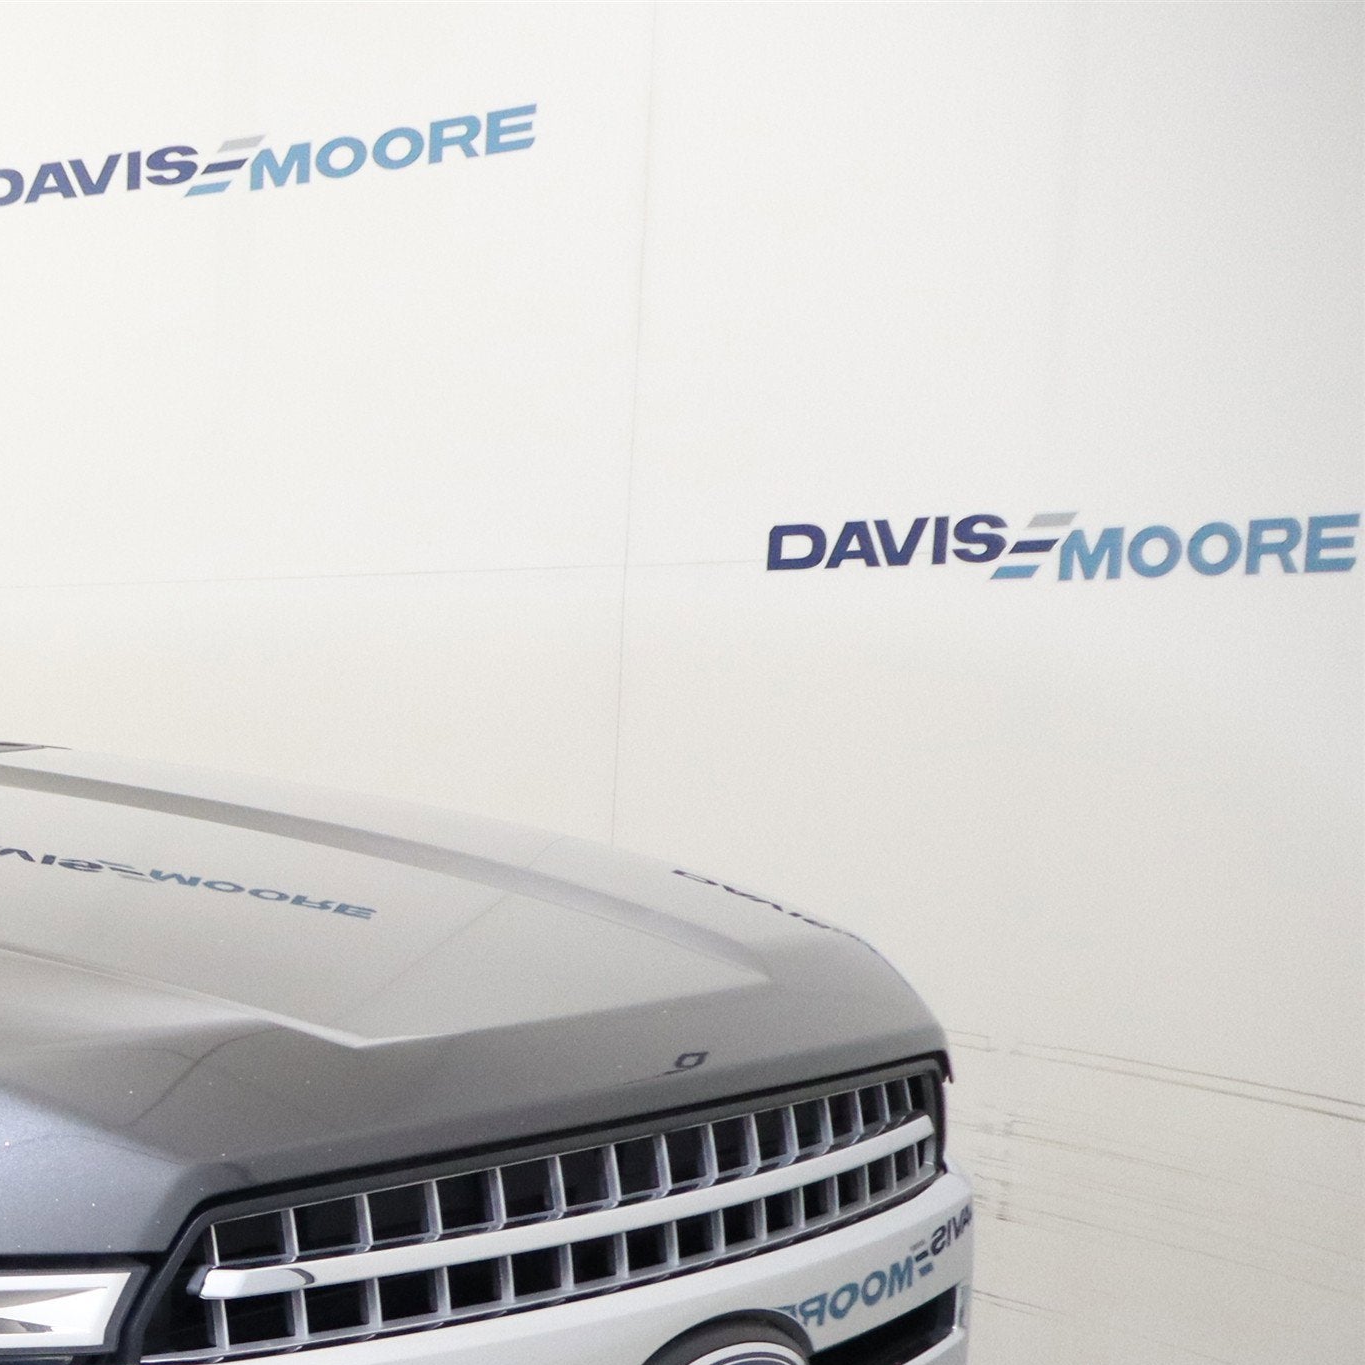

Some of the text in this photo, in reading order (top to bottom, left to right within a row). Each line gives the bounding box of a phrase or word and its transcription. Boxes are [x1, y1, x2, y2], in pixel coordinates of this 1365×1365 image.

[249, 102, 538, 192] MOORE
[766, 512, 1361, 581] DAVIS MOORE
